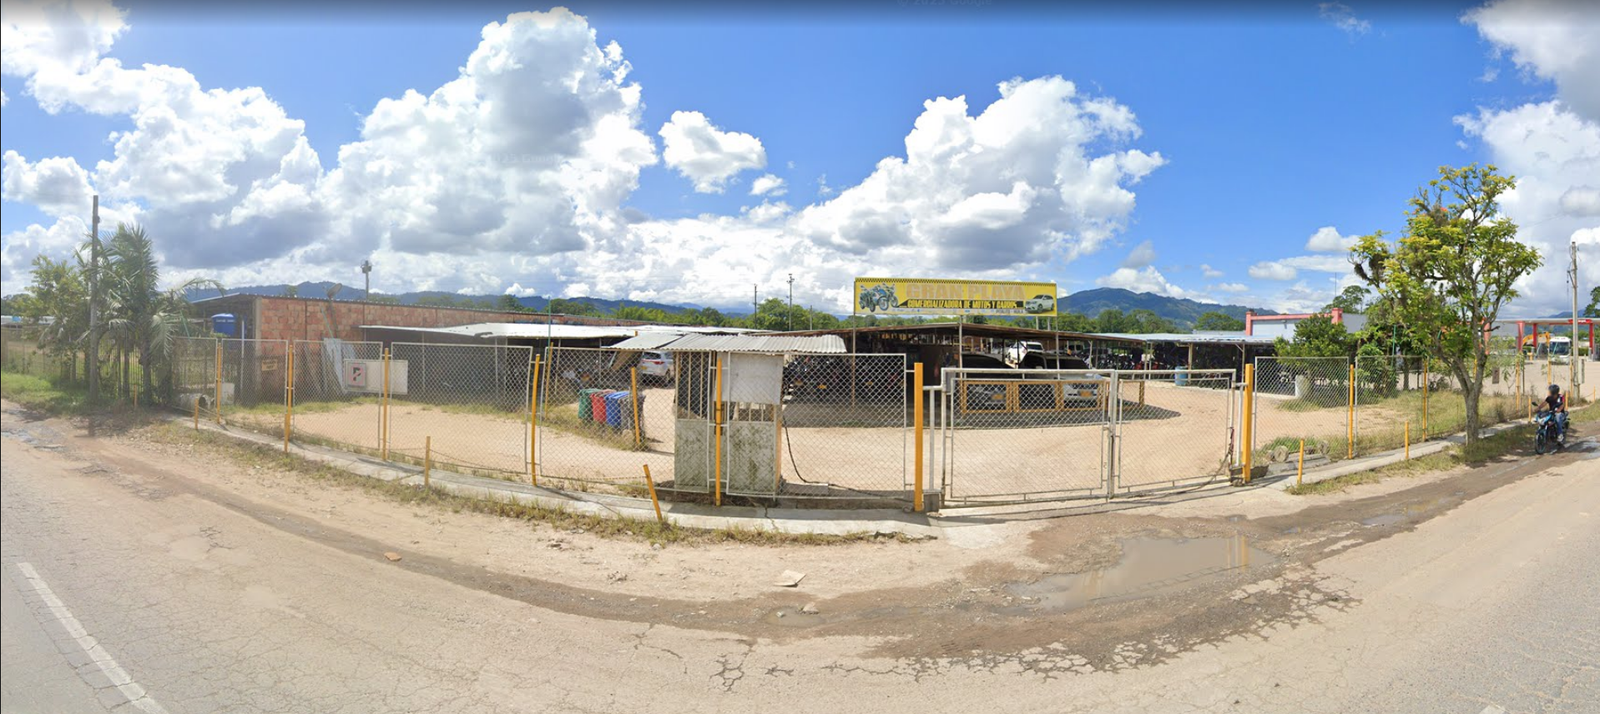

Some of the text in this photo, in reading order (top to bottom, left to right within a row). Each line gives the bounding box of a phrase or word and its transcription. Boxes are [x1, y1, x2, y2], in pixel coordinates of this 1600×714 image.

[906, 283, 1026, 300] GRAN PLAYA
[907, 300, 962, 308] COMERCIALIZADORA
[964, 300, 970, 309] DE
[972, 300, 991, 309] MOTOS
